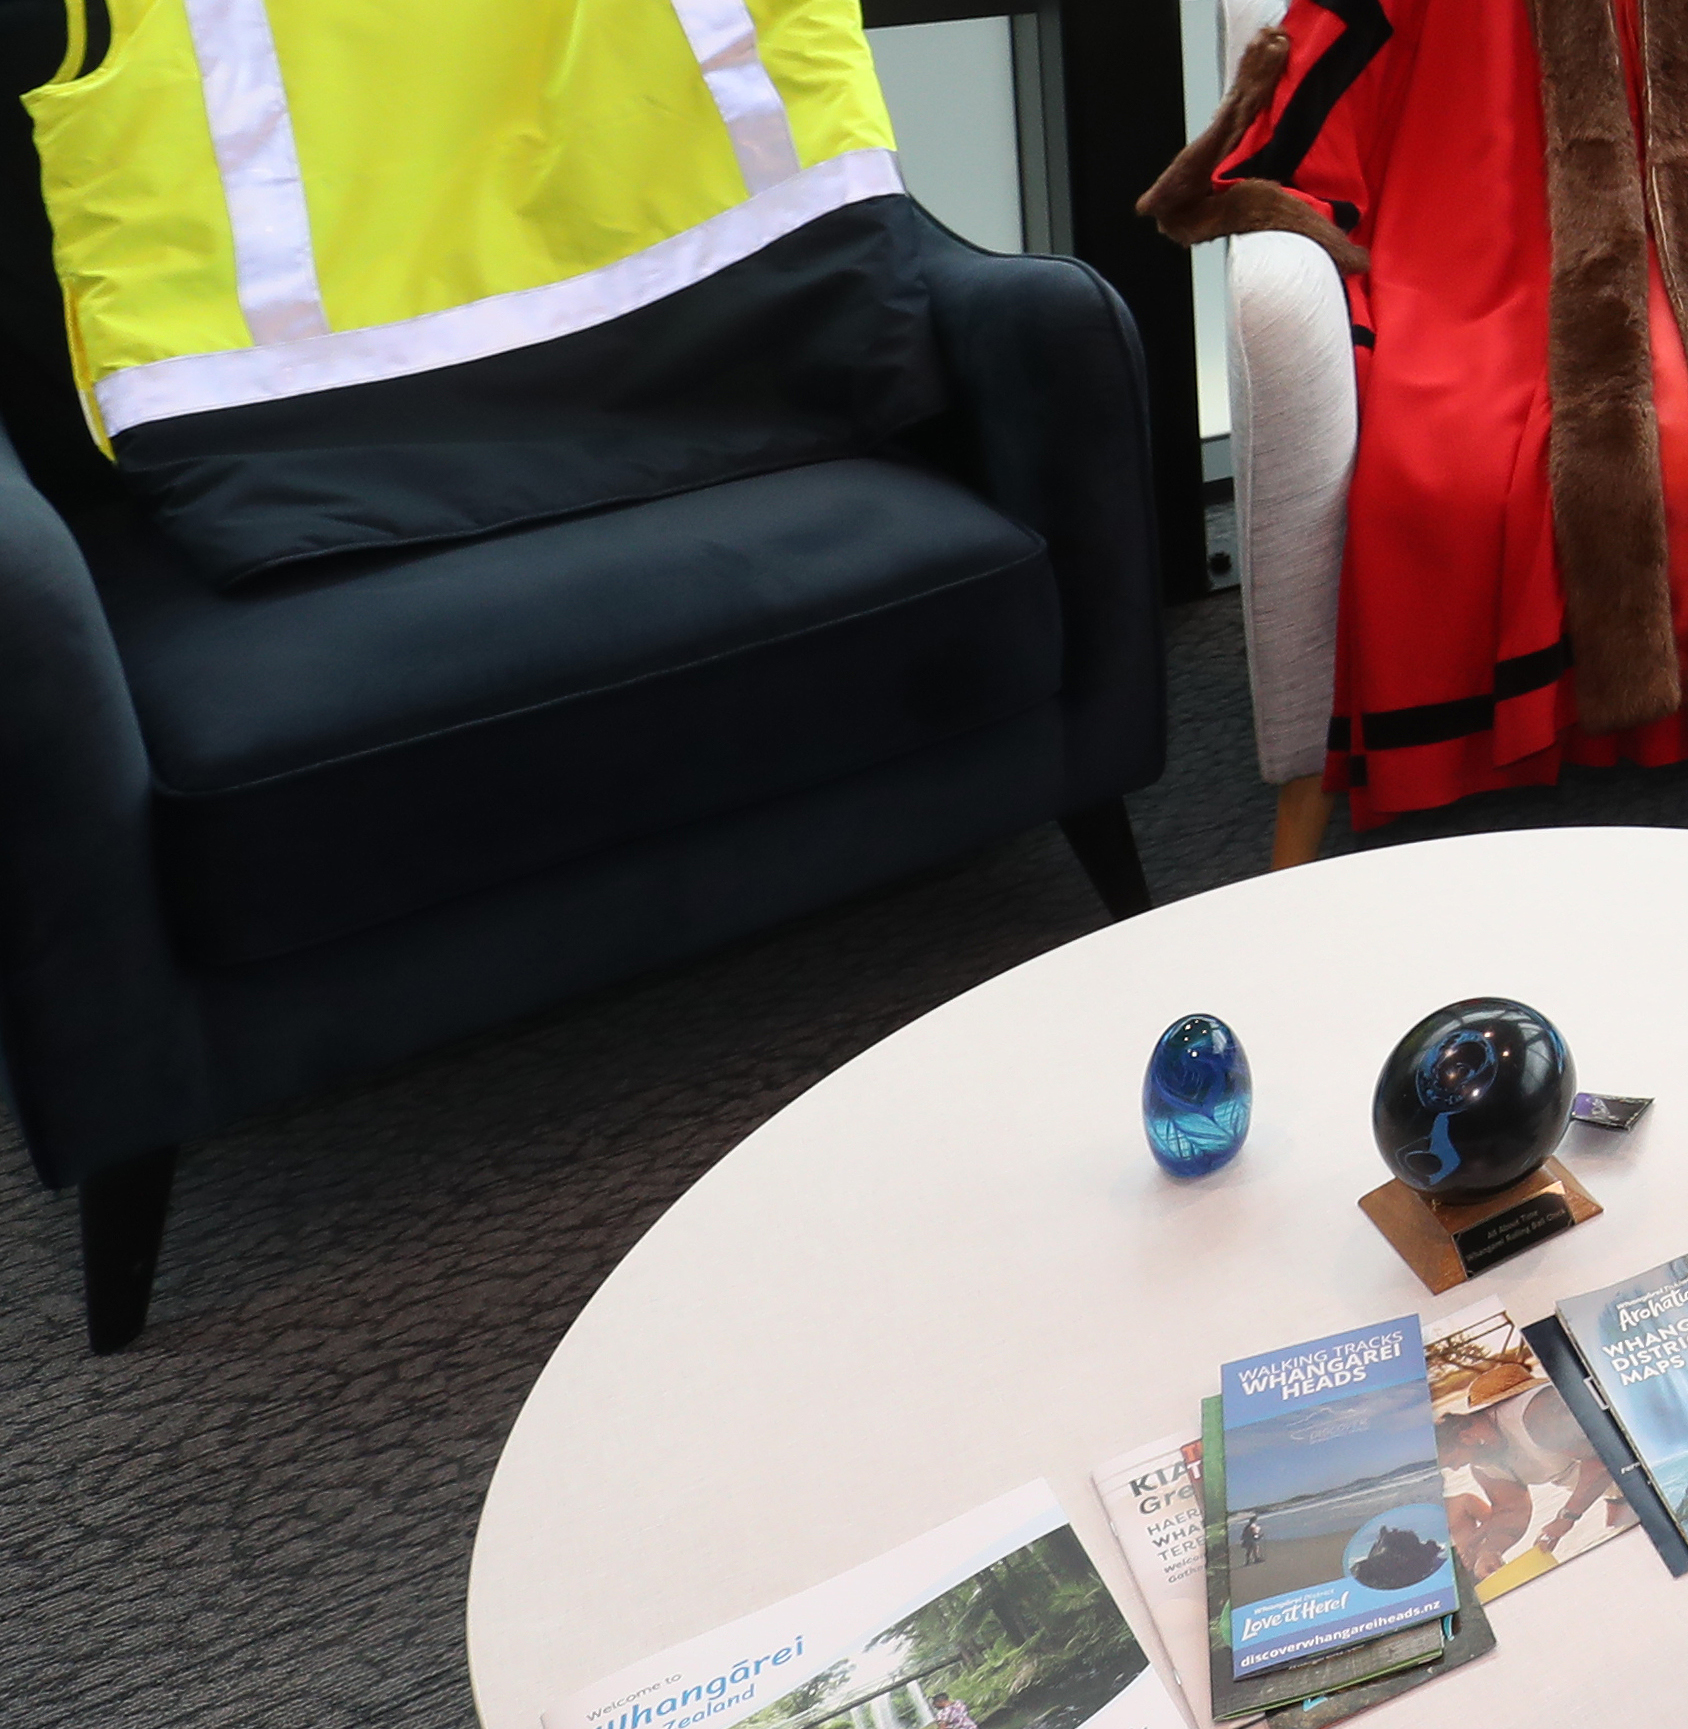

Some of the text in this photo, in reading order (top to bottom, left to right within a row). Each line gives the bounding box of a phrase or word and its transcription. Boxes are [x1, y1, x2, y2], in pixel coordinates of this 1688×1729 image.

[1238, 1330, 1404, 1383] WALKING TRACKS
[1242, 1343, 1402, 1396] WHANGAREI
[1620, 1354, 1686, 1386] MAPS
[1282, 1366, 1367, 1401] HEADS
[1240, 1600, 1442, 1669] discoverwhangareiheads.nz
[1241, 1591, 1350, 1642] Love it Here!
[585, 1673, 683, 1722] Welcome to
